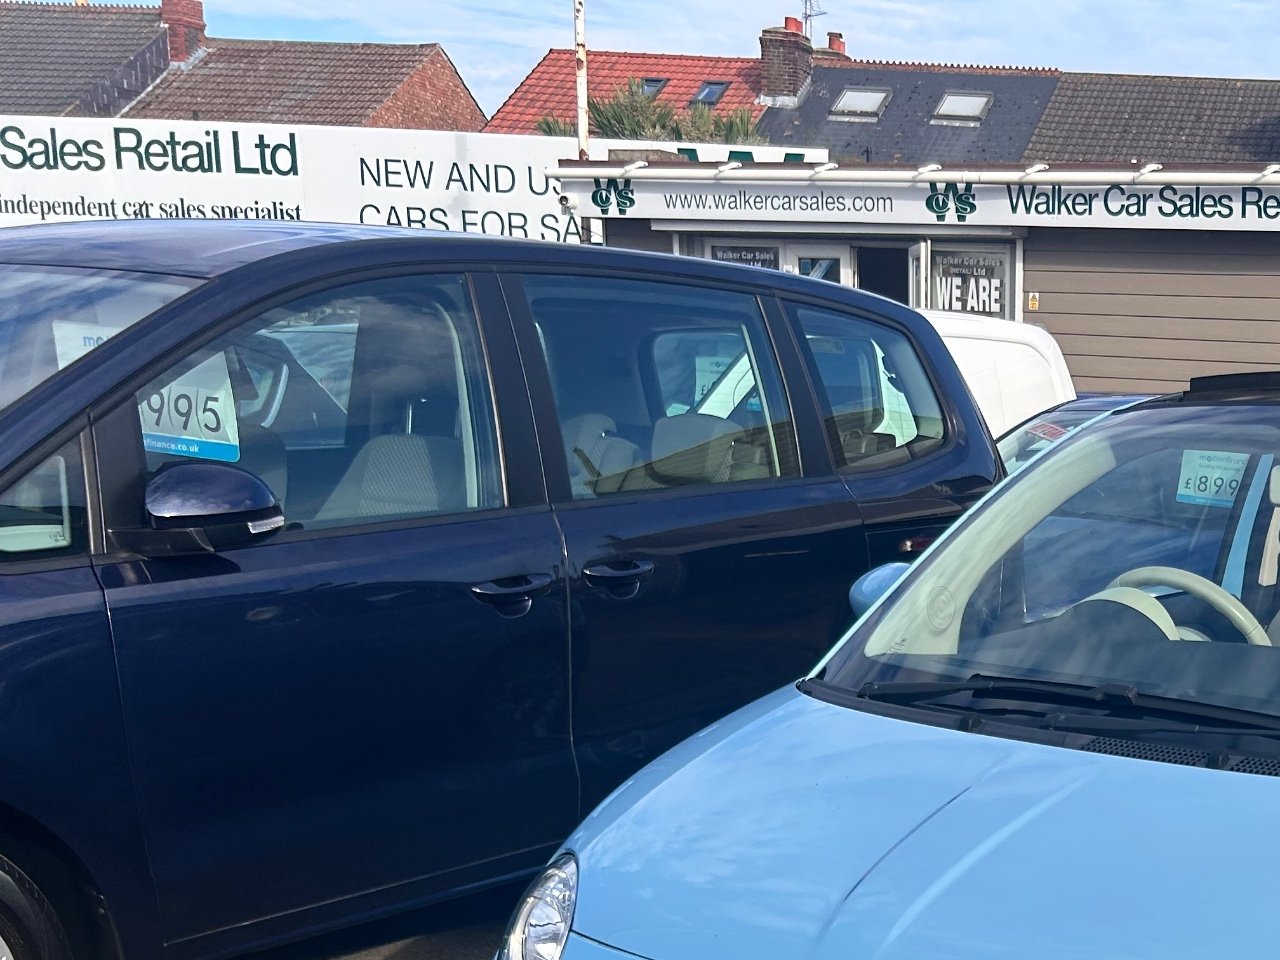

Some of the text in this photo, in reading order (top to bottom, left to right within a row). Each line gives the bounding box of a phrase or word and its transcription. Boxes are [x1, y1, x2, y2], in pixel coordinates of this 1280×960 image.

[0, 125, 299, 176] Sales Retail Ltd
[360, 157, 434, 189] NEW
[445, 162, 516, 194] AND
[0, 193, 302, 220] independent car sales specialist
[664, 190, 894, 213] www.walkercarsales.com
[1006, 184, 1099, 216] Walker
[1103, 184, 1153, 217] Car
[1158, 185, 1233, 220] Sales
[461, 210, 528, 239] FOR
[973, 267, 986, 276] Ltd
[936, 277, 1001, 312] WE ARE
